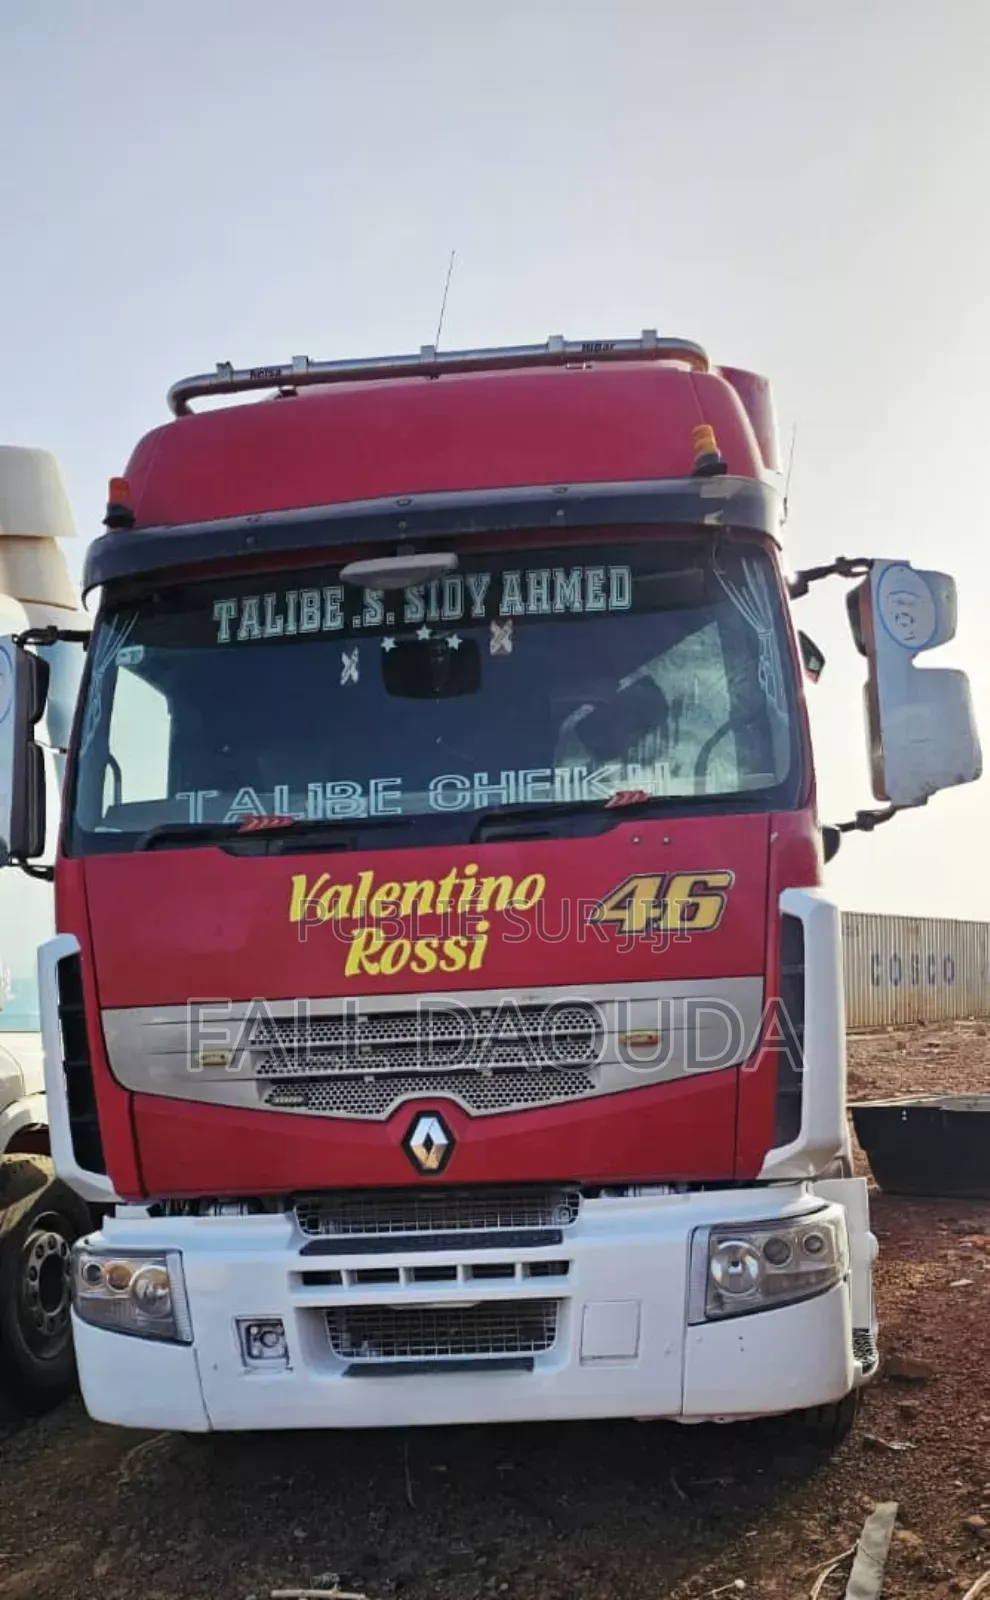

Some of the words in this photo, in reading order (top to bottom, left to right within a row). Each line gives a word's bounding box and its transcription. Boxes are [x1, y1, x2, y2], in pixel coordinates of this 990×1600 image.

[213, 586, 344, 643] TALIBE
[404, 572, 491, 623] SIDY
[499, 565, 632, 616] AHMED
[175, 777, 403, 824] TALIBE
[289, 863, 546, 922] Valentino
[586, 869, 735, 936] 46
[344, 920, 489, 977] Rossi
[870, 951, 956, 987] COSCO
